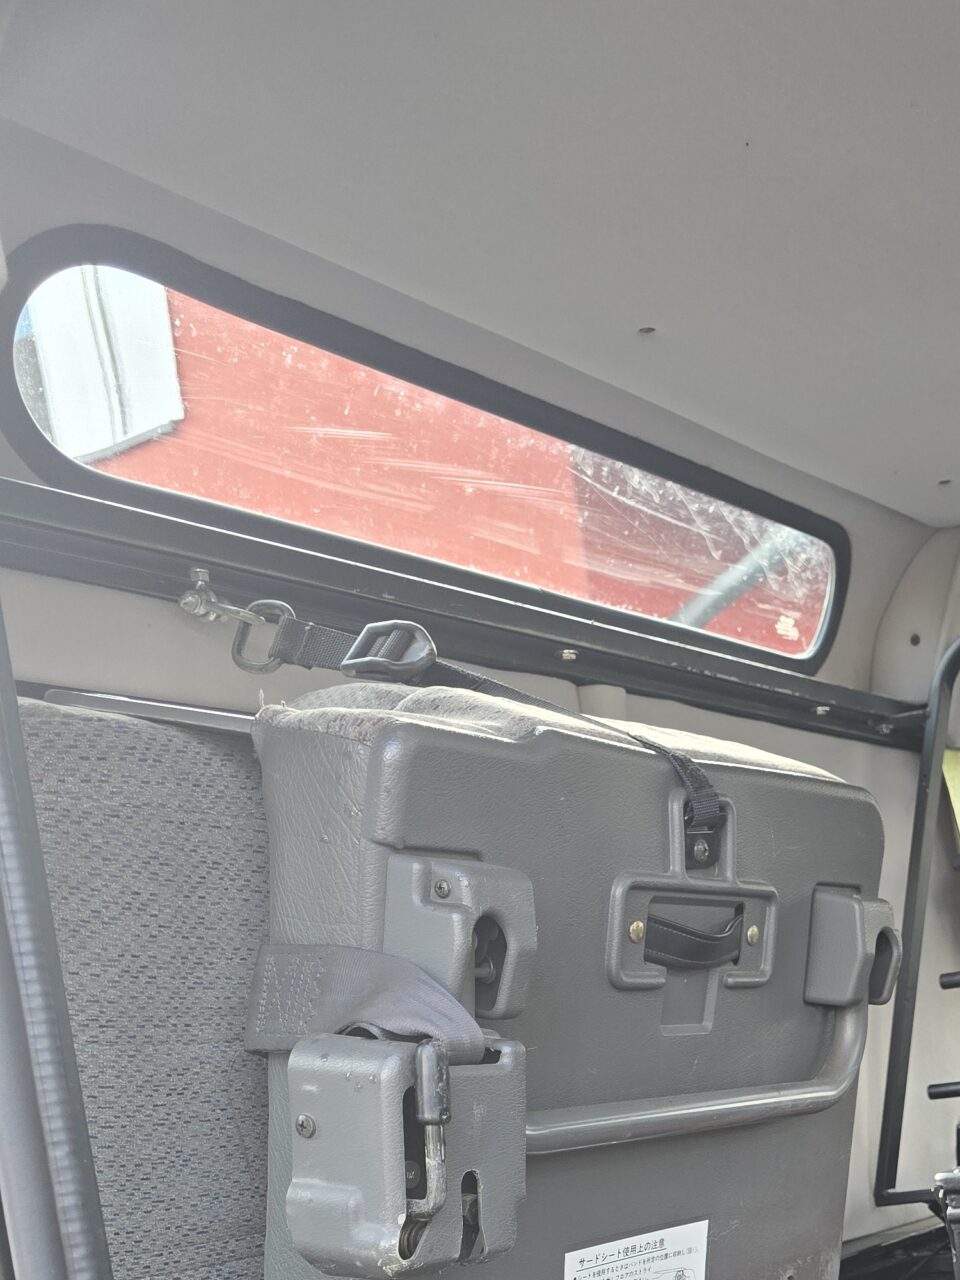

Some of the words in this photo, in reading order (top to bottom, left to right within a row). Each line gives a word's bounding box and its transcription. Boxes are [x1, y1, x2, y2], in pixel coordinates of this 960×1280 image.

[579, 1238, 665, 1268] サードシート使用上の注意
